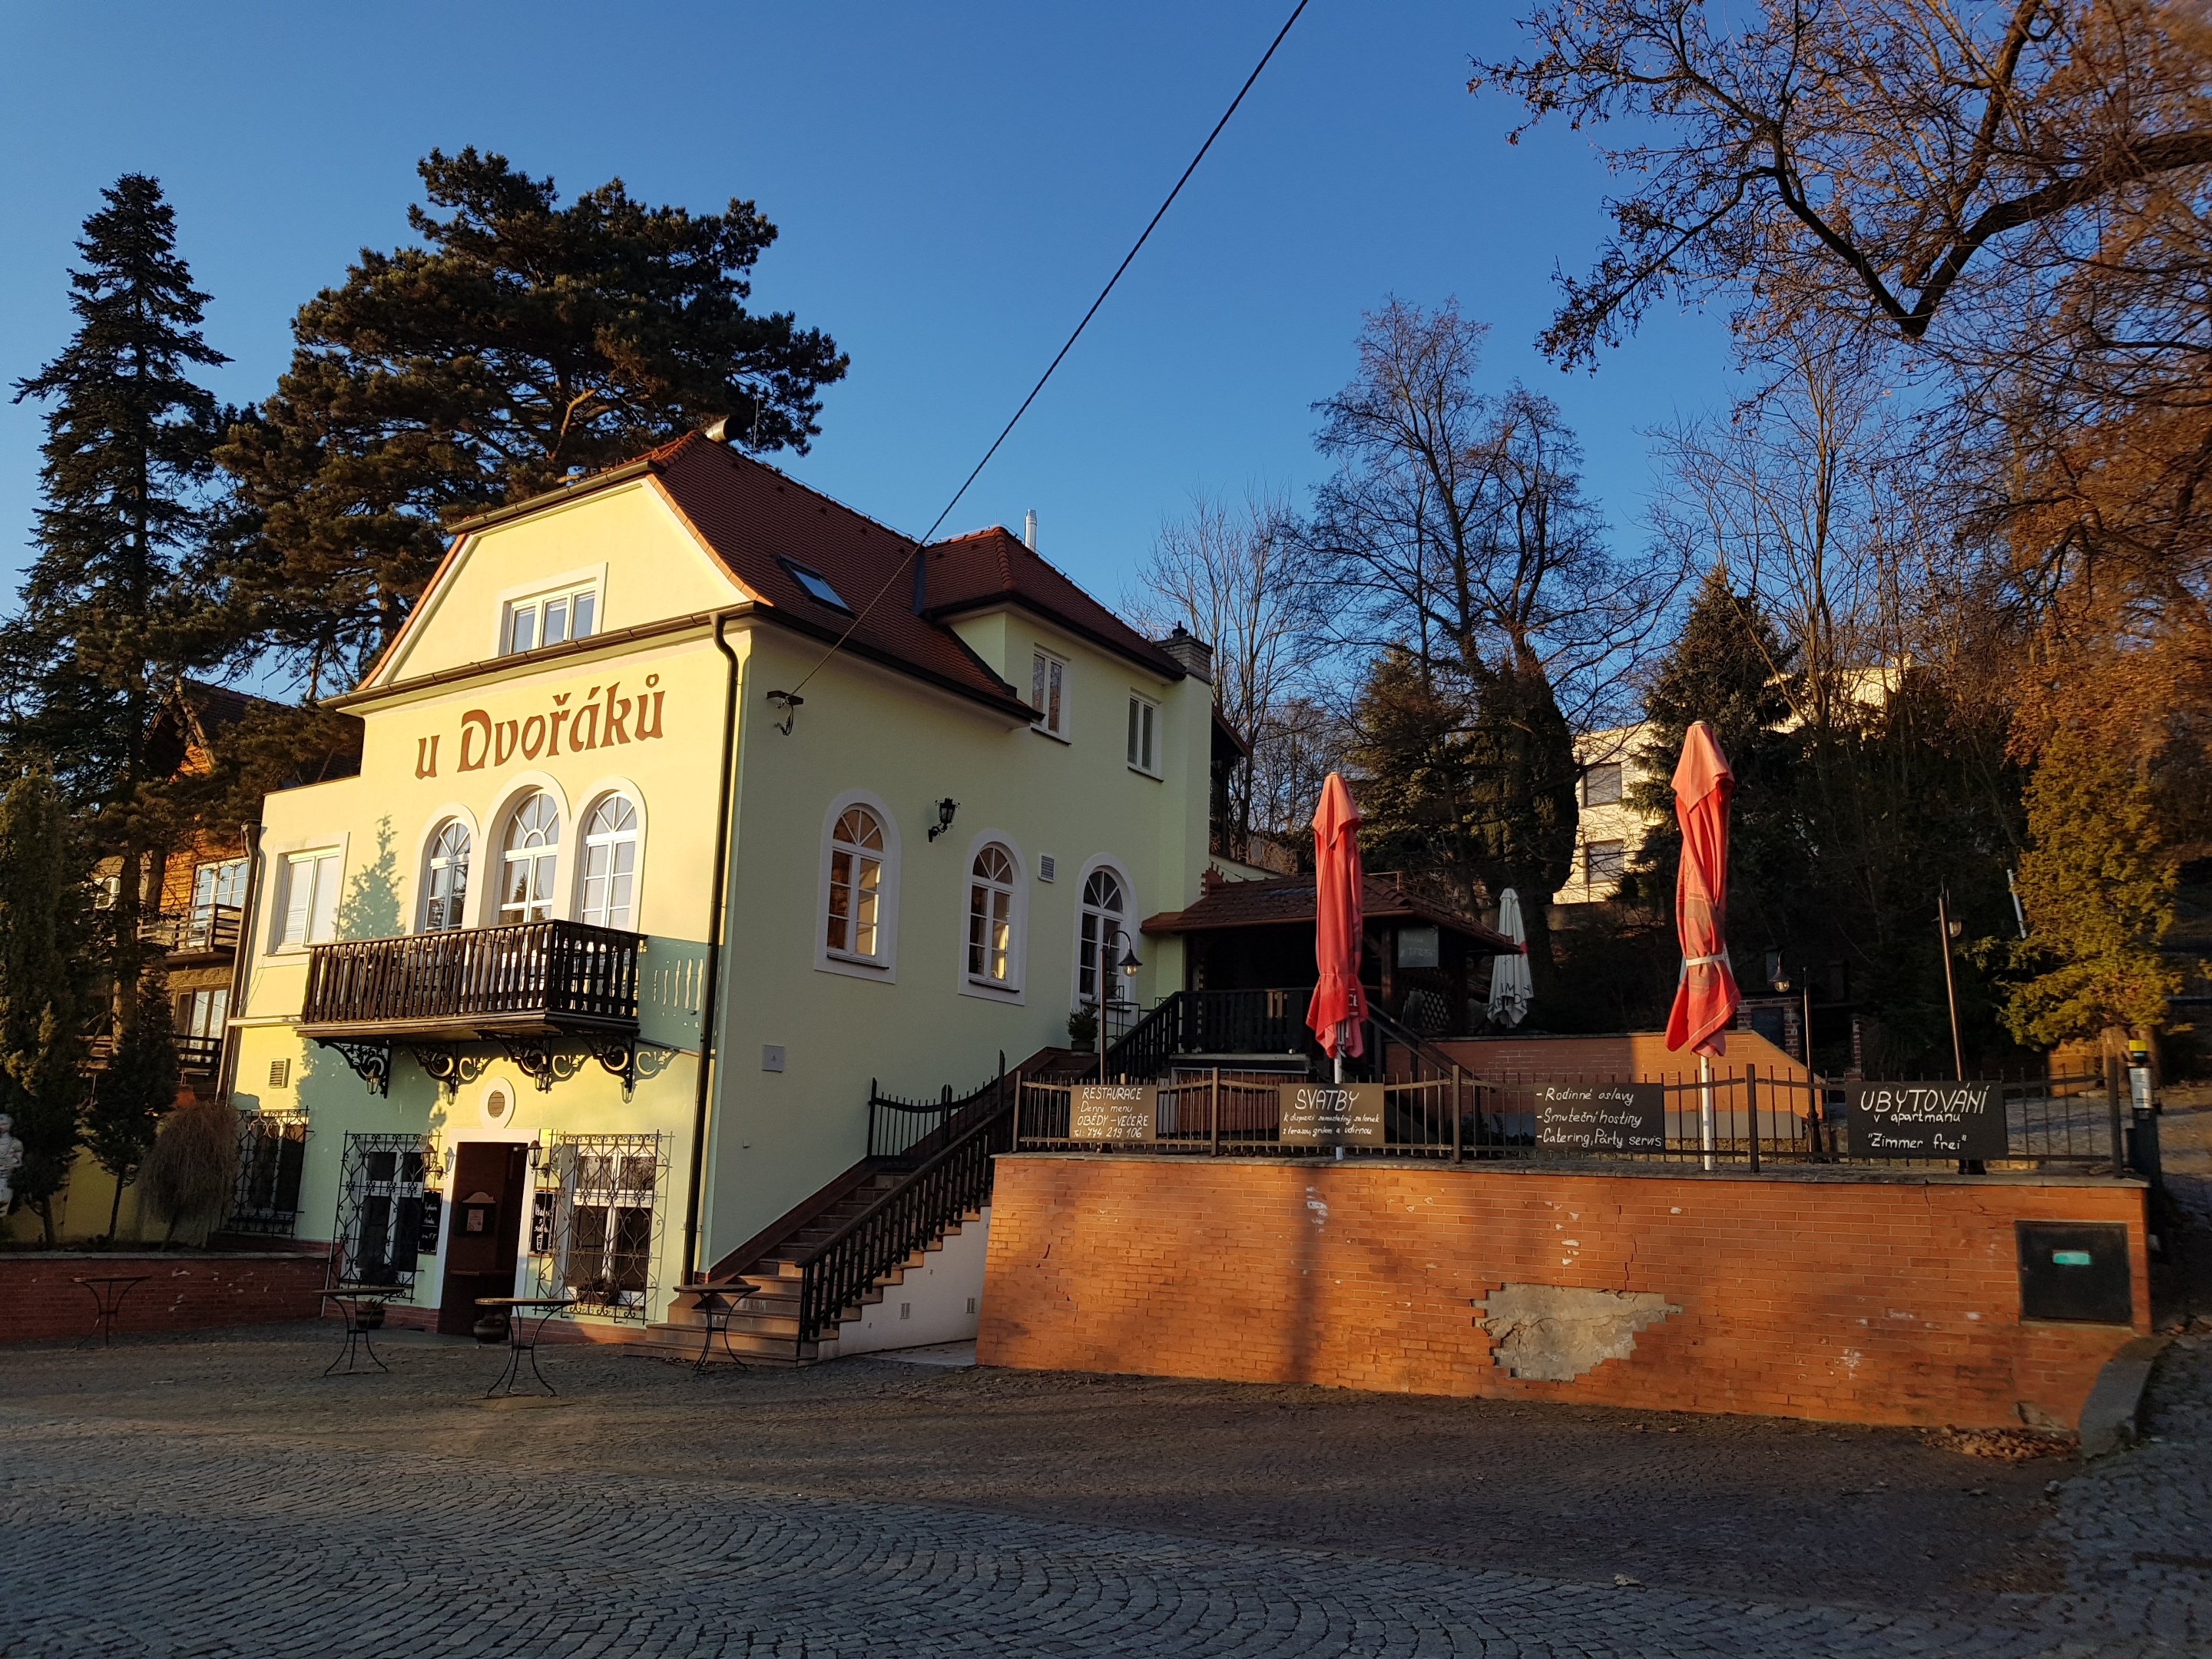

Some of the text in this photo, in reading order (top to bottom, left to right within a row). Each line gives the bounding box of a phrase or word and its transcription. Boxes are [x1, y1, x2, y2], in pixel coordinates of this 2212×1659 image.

[415, 673, 666, 780] u Dvořáků
[1081, 1087, 1143, 1100] RESTAURACE
[1294, 1088, 1359, 1111] SVATBY
[1598, 1087, 1634, 1106] oslavy
[1860, 1082, 1991, 1114] UBYTOVÁNÍ
[1353, 1114, 1379, 1123] salonek
[1599, 1109, 1643, 1128] hostiny
[1890, 1109, 1961, 1126] apartmánu
[1088, 1127, 1102, 1137] 774
[1106, 1127, 1122, 1137] 219
[1126, 1127, 1143, 1137] 106
[1628, 1134, 1662, 1147] servis
